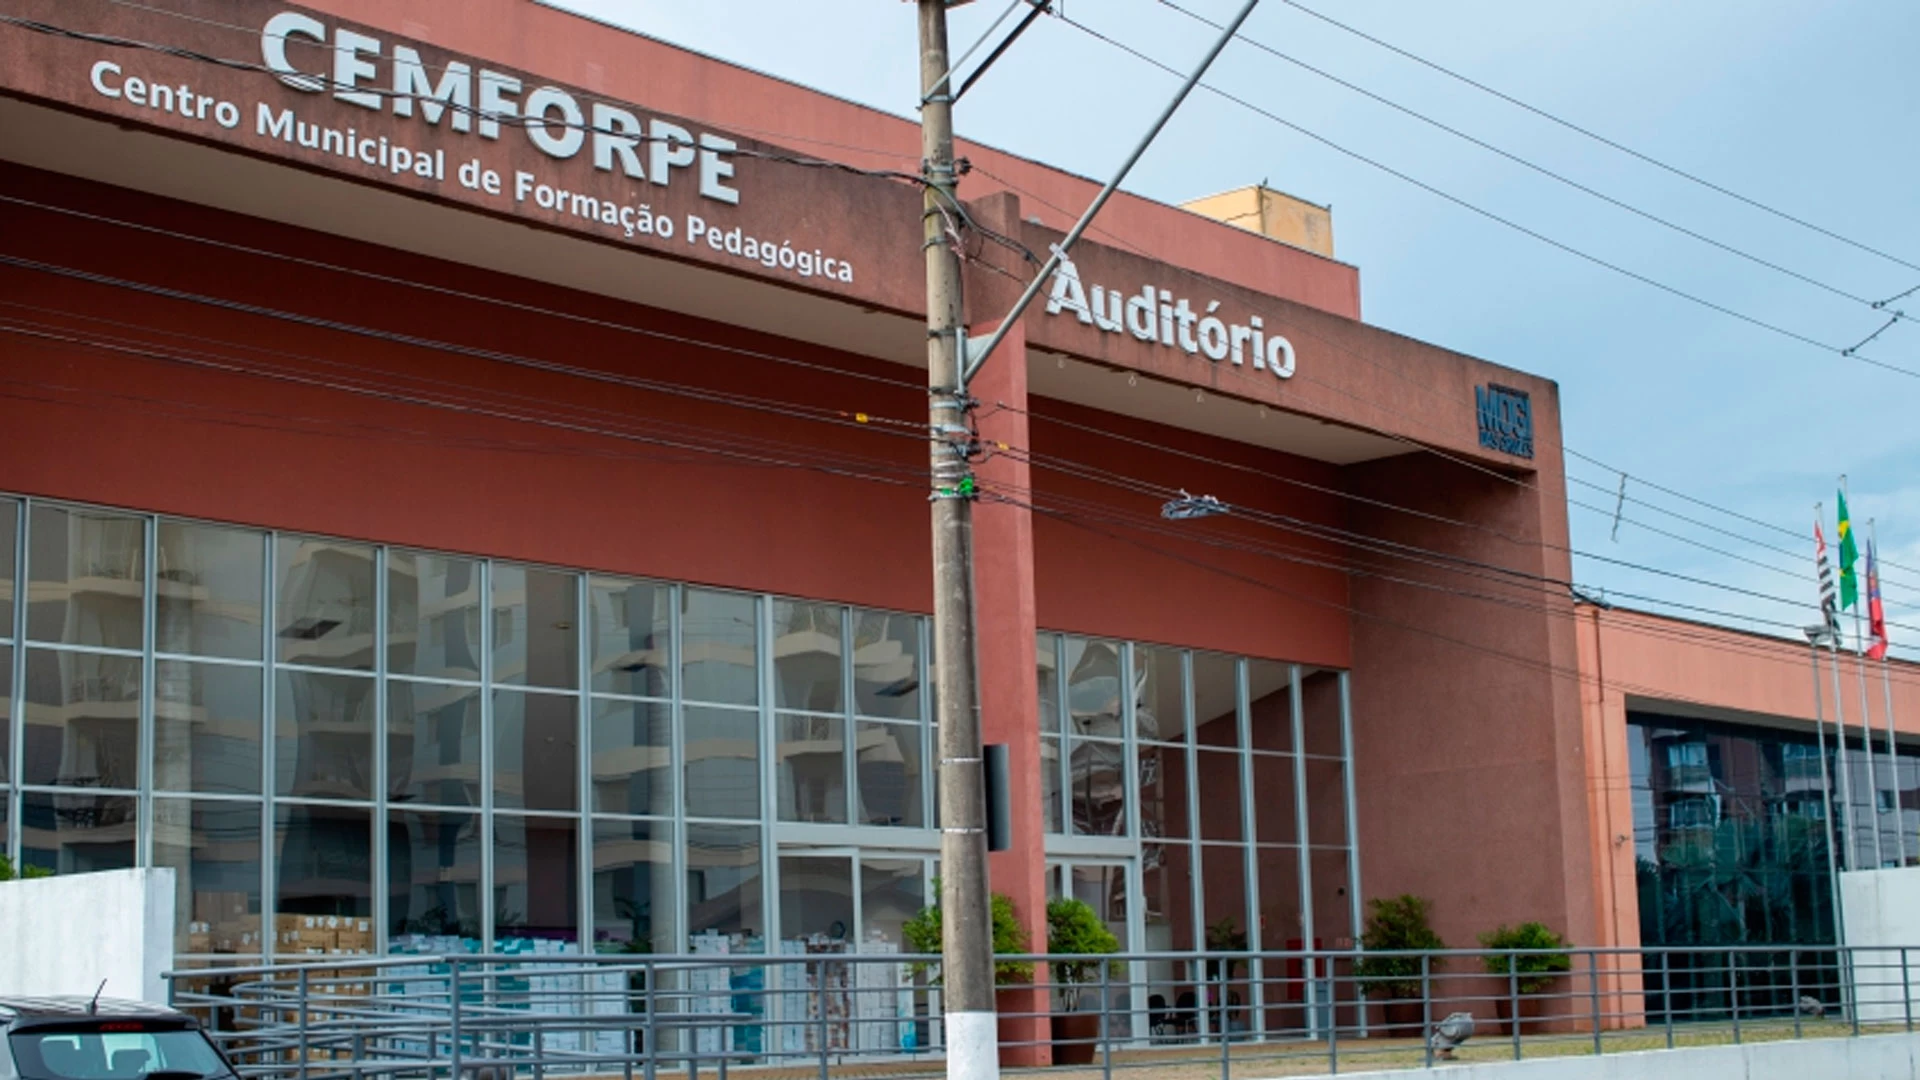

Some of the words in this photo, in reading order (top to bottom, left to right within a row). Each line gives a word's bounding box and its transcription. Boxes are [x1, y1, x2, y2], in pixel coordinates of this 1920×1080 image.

[90, 60, 240, 129] Centro
[256, 102, 444, 181] Municipal
[459, 158, 501, 195] de
[515, 171, 674, 239] Formação
[687, 214, 854, 284] Pedagógica
[261, 11, 739, 205] CEMFORPE
[1045, 258, 1296, 379] Auditório
